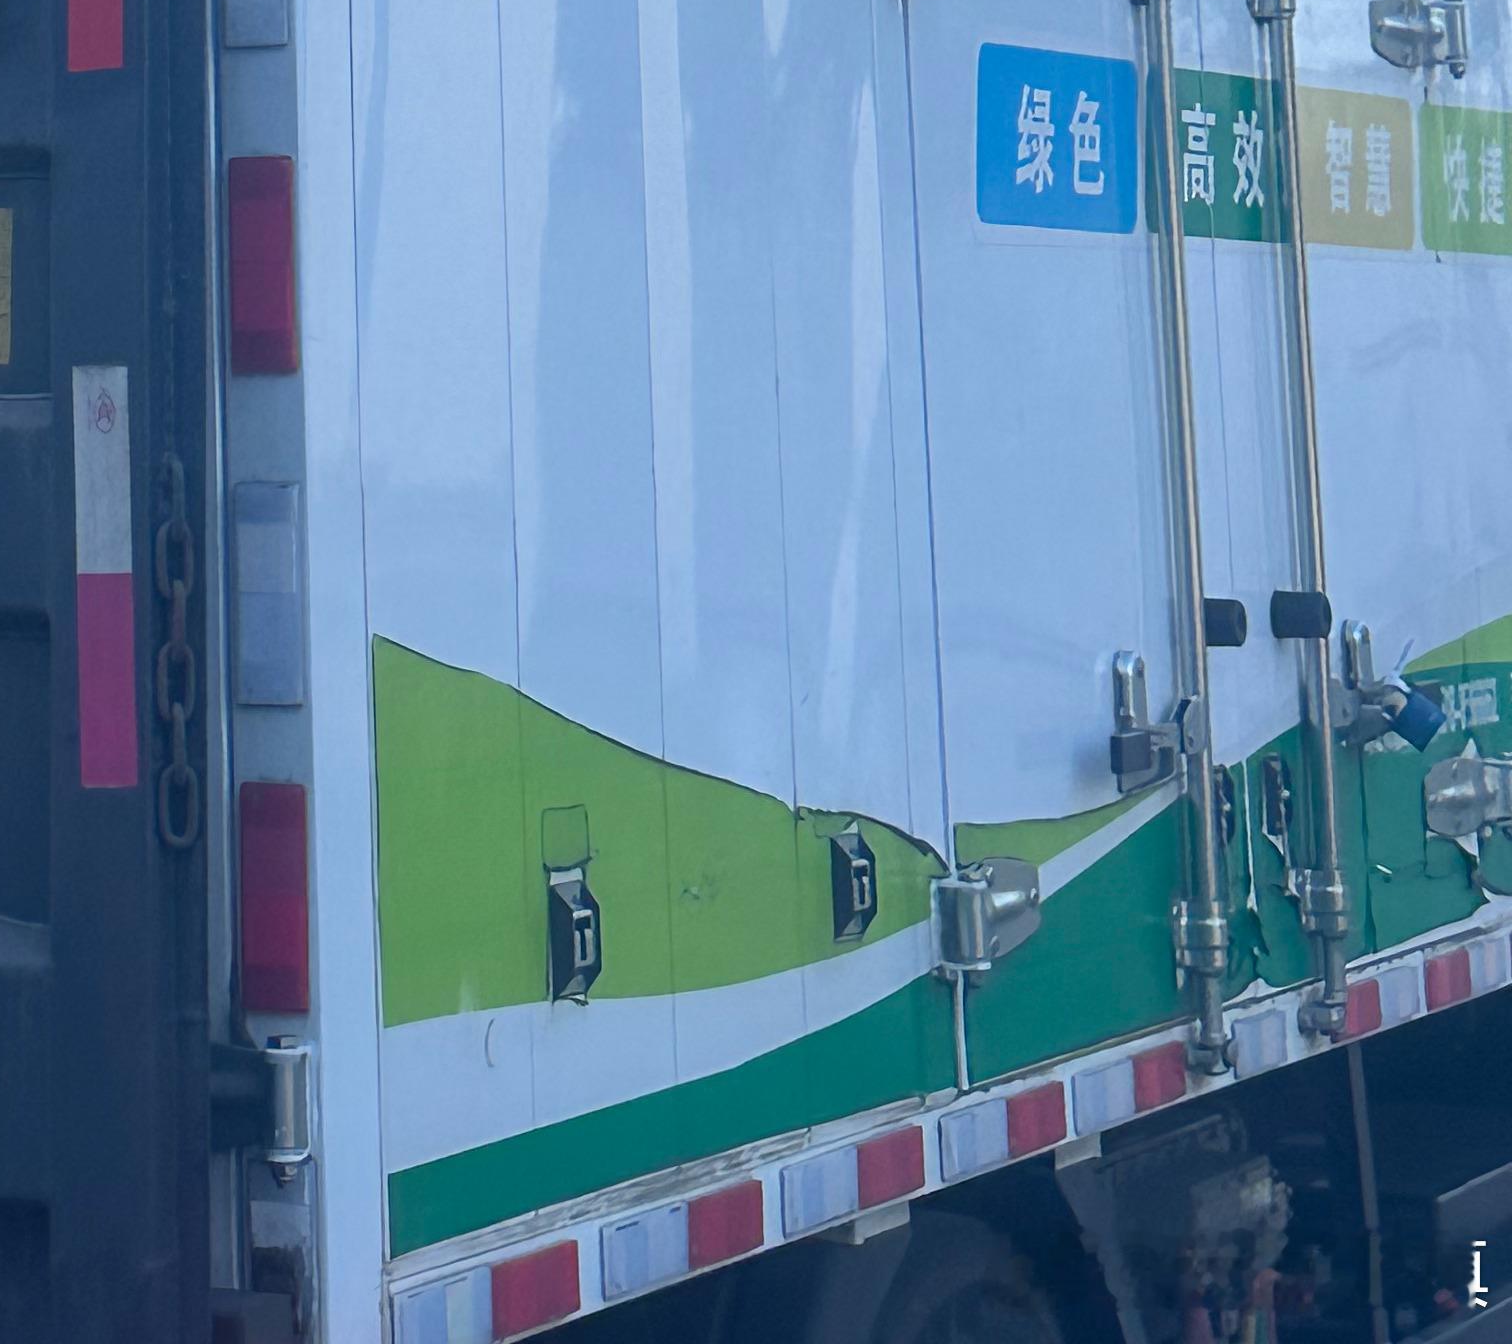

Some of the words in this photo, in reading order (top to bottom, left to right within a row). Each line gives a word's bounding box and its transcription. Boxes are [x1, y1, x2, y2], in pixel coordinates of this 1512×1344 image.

[1015, 83, 1105, 196] 绿色
[1181, 101, 1265, 208] 高效
[1325, 118, 1392, 217] 智慧
